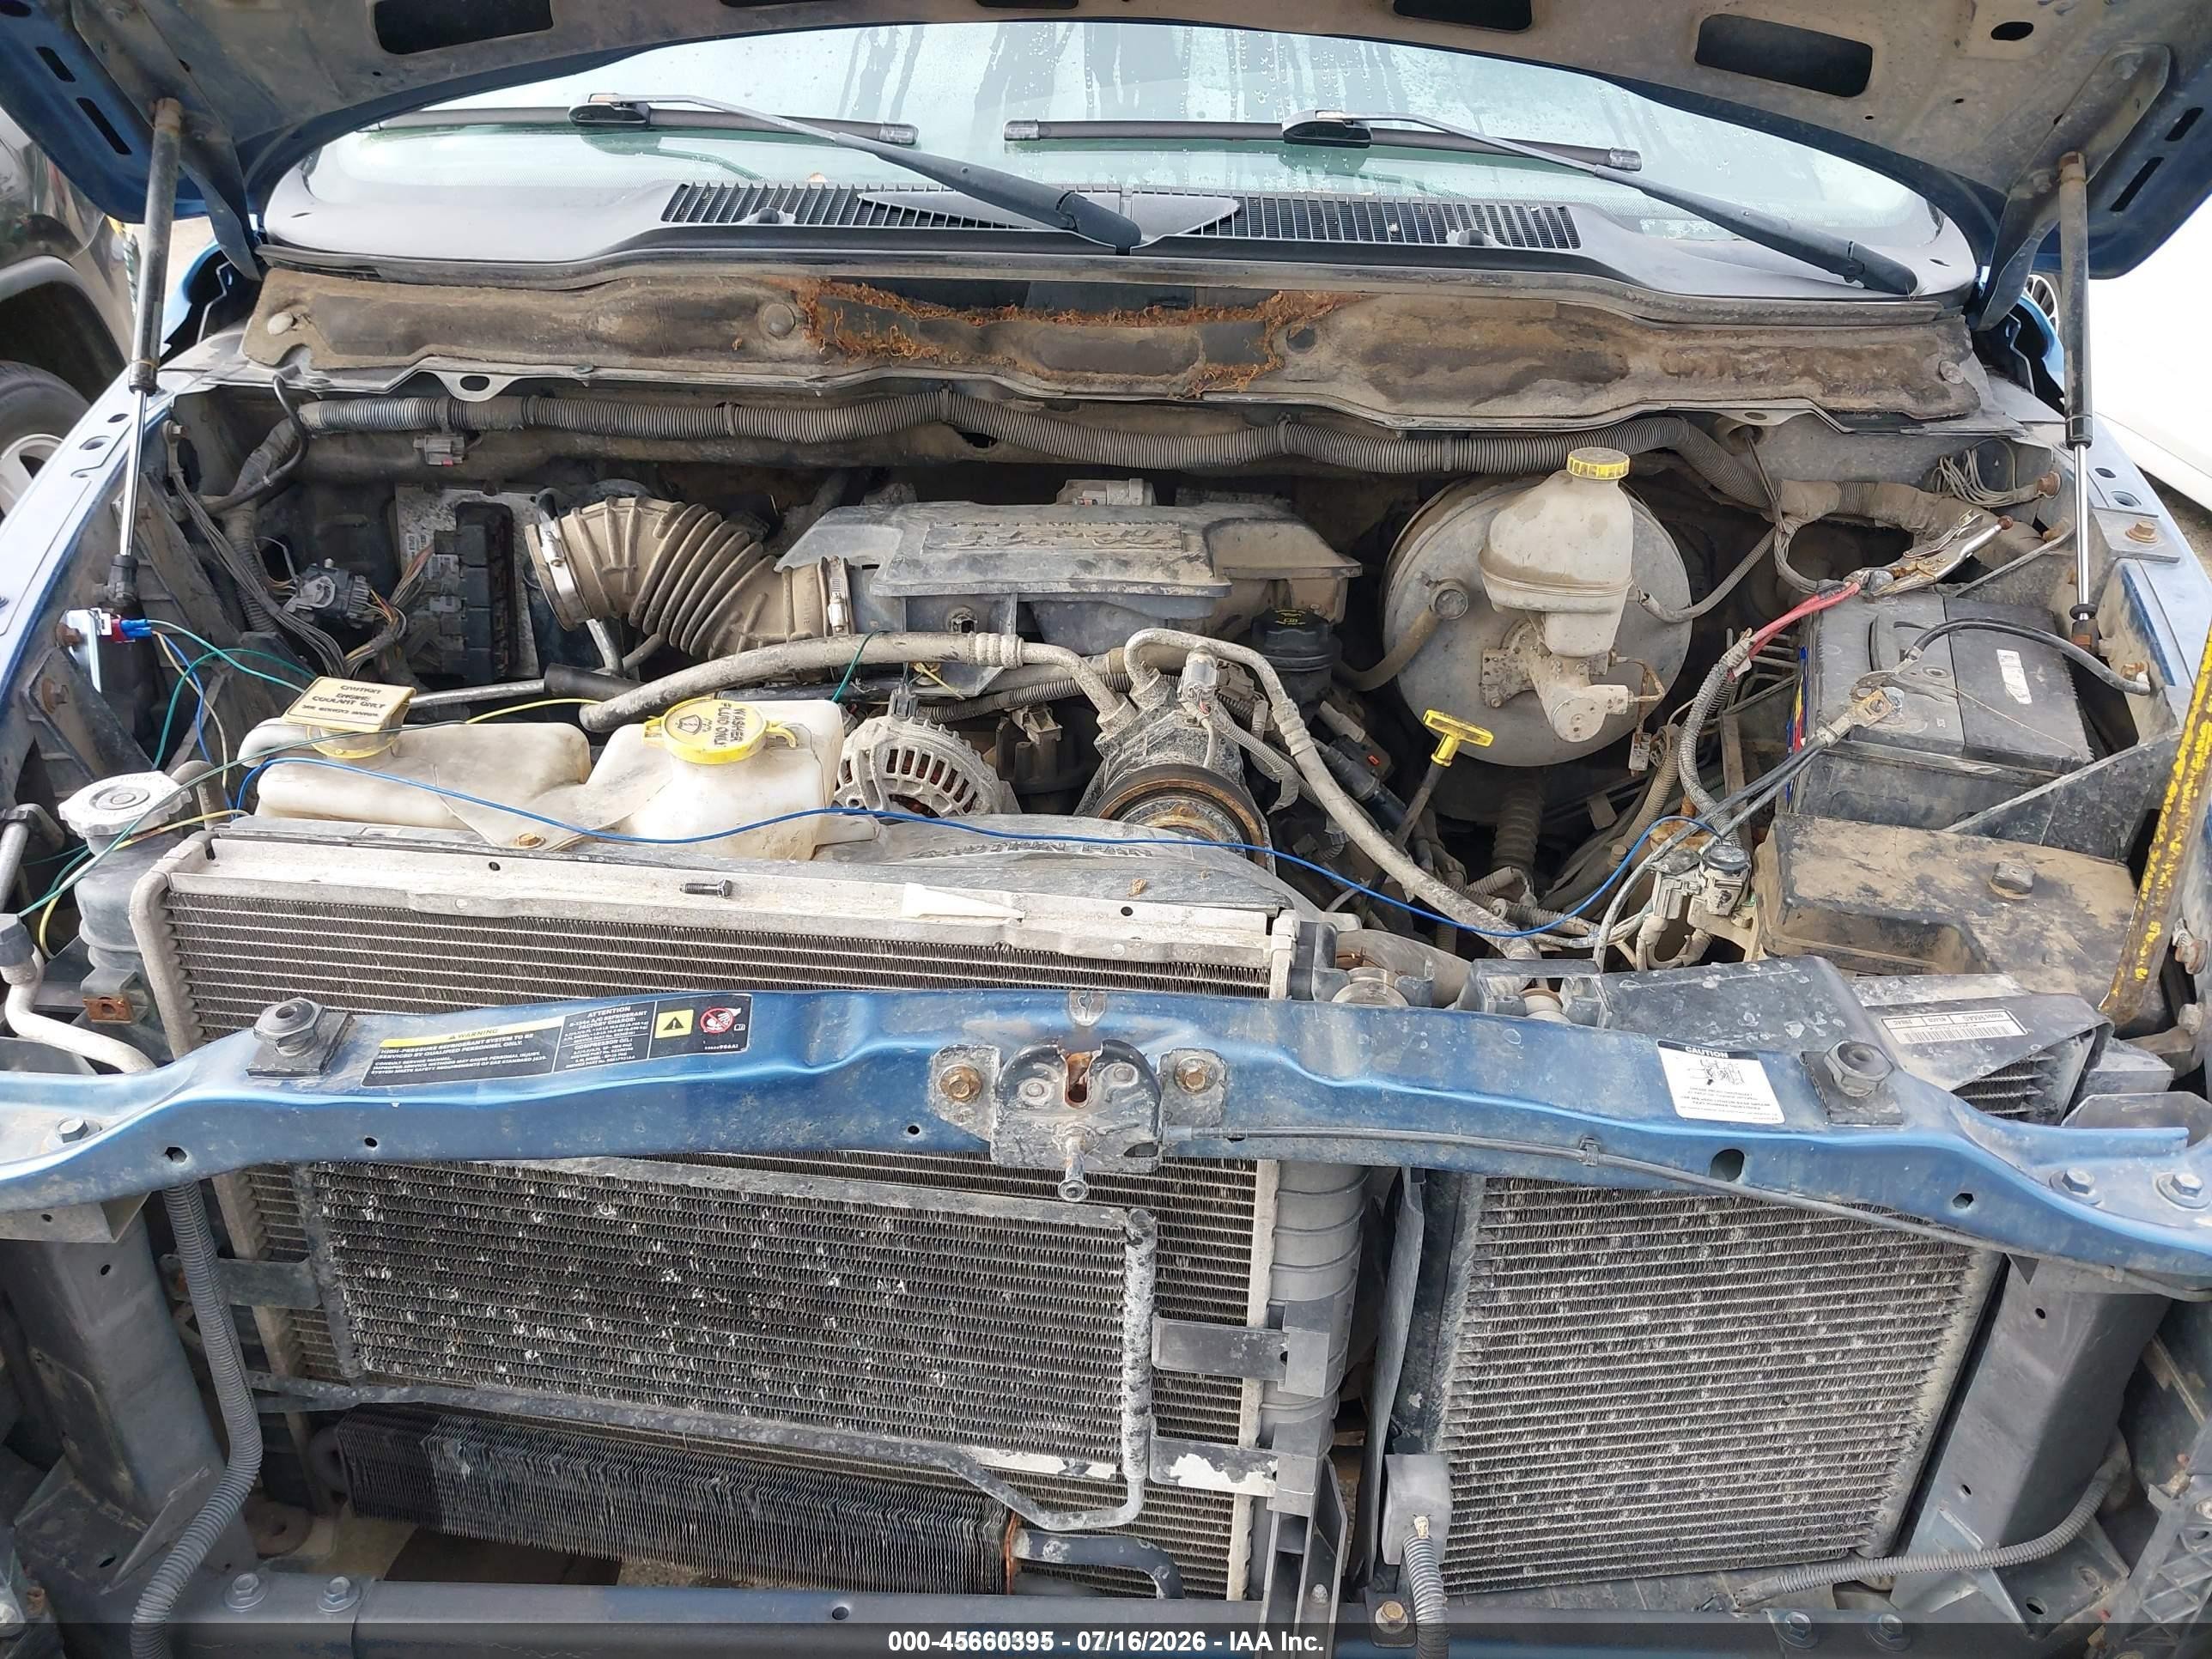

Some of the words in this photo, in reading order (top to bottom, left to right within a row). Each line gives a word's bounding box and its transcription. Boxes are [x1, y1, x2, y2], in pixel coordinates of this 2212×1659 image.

[312, 696, 357, 705] COOLANT
[717, 702, 732, 726] FLUID
[730, 708, 746, 742] WASHER
[714, 726, 729, 747] ONLY
[587, 1006, 631, 1018] ATTENTION
[604, 1011, 647, 1021] REFRIGERANT
[458, 1029, 498, 1039] WARNING
[424, 1048, 460, 1056] QUALIFIED
[461, 1043, 501, 1052] PERSONNEL
[438, 1039, 486, 1049] REFRIGERANT
[574, 1039, 618, 1050] COMPRESSOR
[1685, 1046, 1729, 1059] CAUTION
